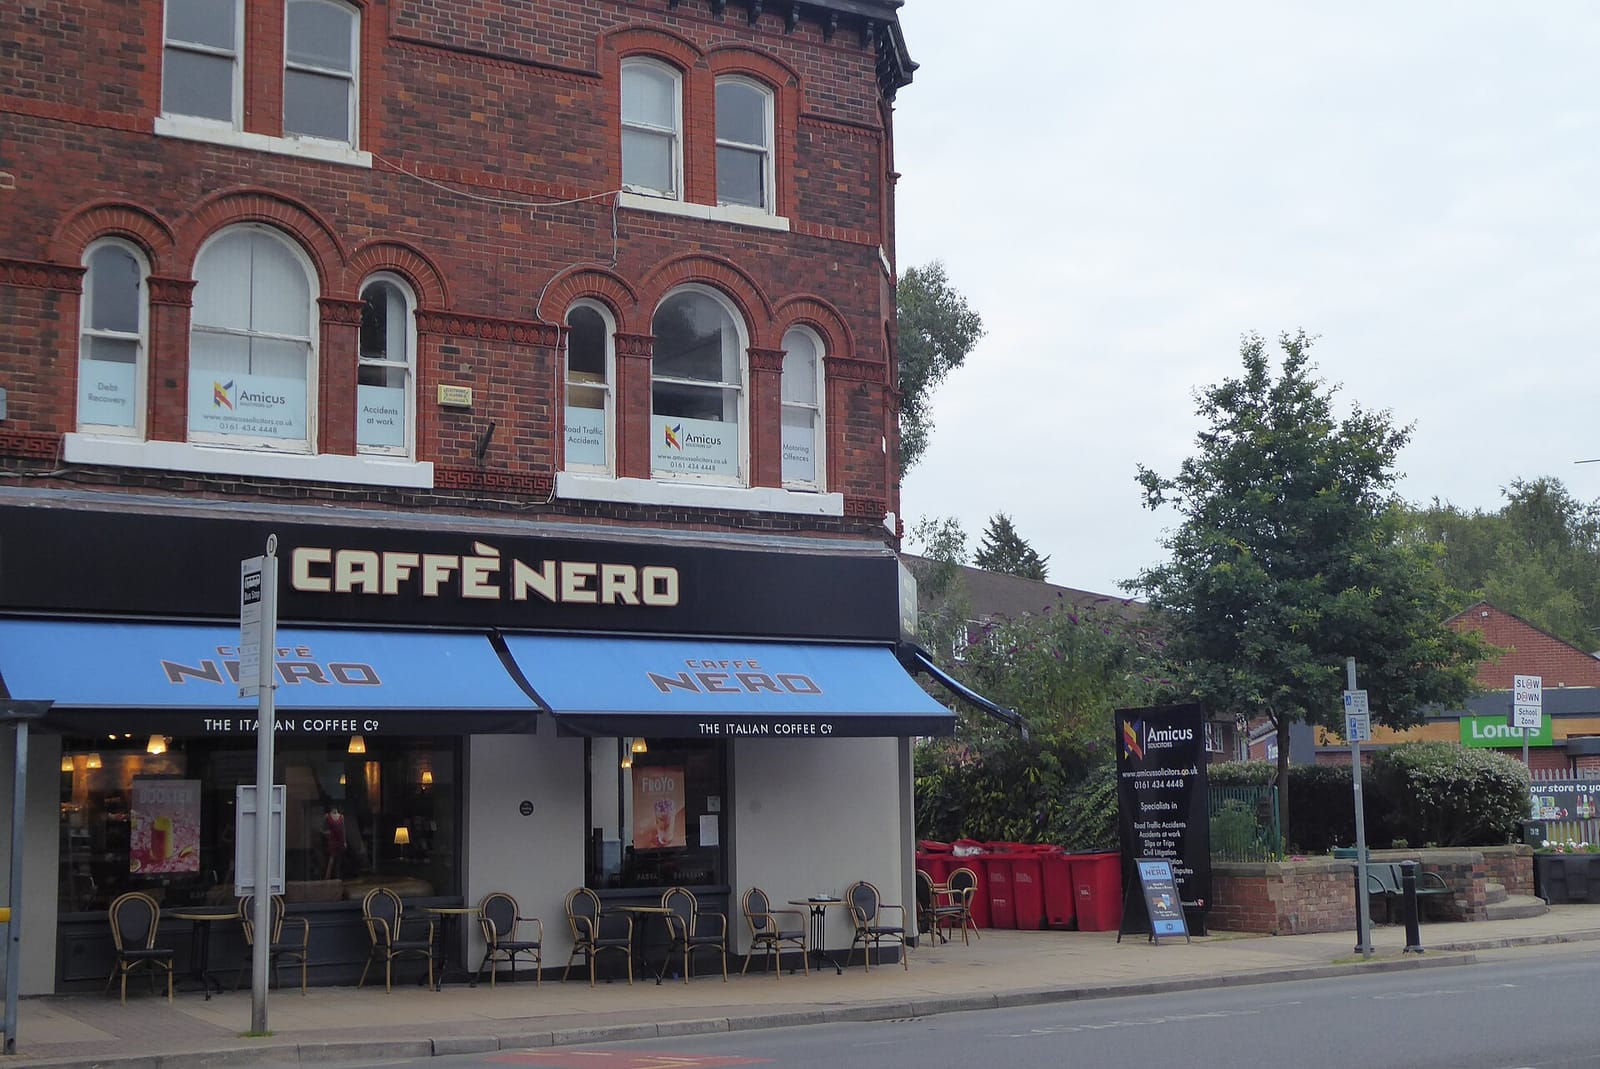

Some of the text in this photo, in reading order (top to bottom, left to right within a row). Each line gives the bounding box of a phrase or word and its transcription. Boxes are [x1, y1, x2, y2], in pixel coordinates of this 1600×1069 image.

[97, 381, 119, 392] Debt
[88, 392, 127, 405] Recovery
[240, 390, 286, 405] Amicus
[363, 405, 399, 416] Accidents
[376, 418, 395, 426] work
[219, 422, 278, 434] 0161 434 4448
[582, 426, 603, 436] Traffic
[567, 436, 600, 446] Accidents
[685, 432, 722, 446] Amicus
[783, 444, 810, 454] Motoring
[783, 452, 809, 462] Offences
[670, 461, 716, 472] 0161 434 4448
[291, 541, 680, 607] CAFFÈ NERO
[647, 671, 824, 696] NERO
[1518, 708, 1538, 717] School
[204, 718, 231, 731] THE
[239, 719, 295, 732] ITAAN
[303, 719, 357, 732] COFFEE
[1521, 717, 1535, 725] Zone
[699, 723, 720, 734] THE
[726, 723, 769, 734] ITALIAN
[774, 724, 816, 734] COFFEE
[1147, 725, 1193, 742] Amicus
[1122, 765, 1199, 778] www.amicussolicitors.co.uk
[1134, 779, 1184, 790] 0161 434 4448
[1530, 785, 1547, 793] our
[1548, 784, 1574, 793] store
[1576, 784, 1587, 792] to
[1140, 801, 1178, 812] Specialists in
[1134, 820, 1187, 829] Road Traffic Accidents
[1139, 830, 1161, 838] Accidents
[1168, 830, 1181, 838] work
[1162, 839, 1175, 848] Trips
[1154, 848, 1177, 857] Litigation
